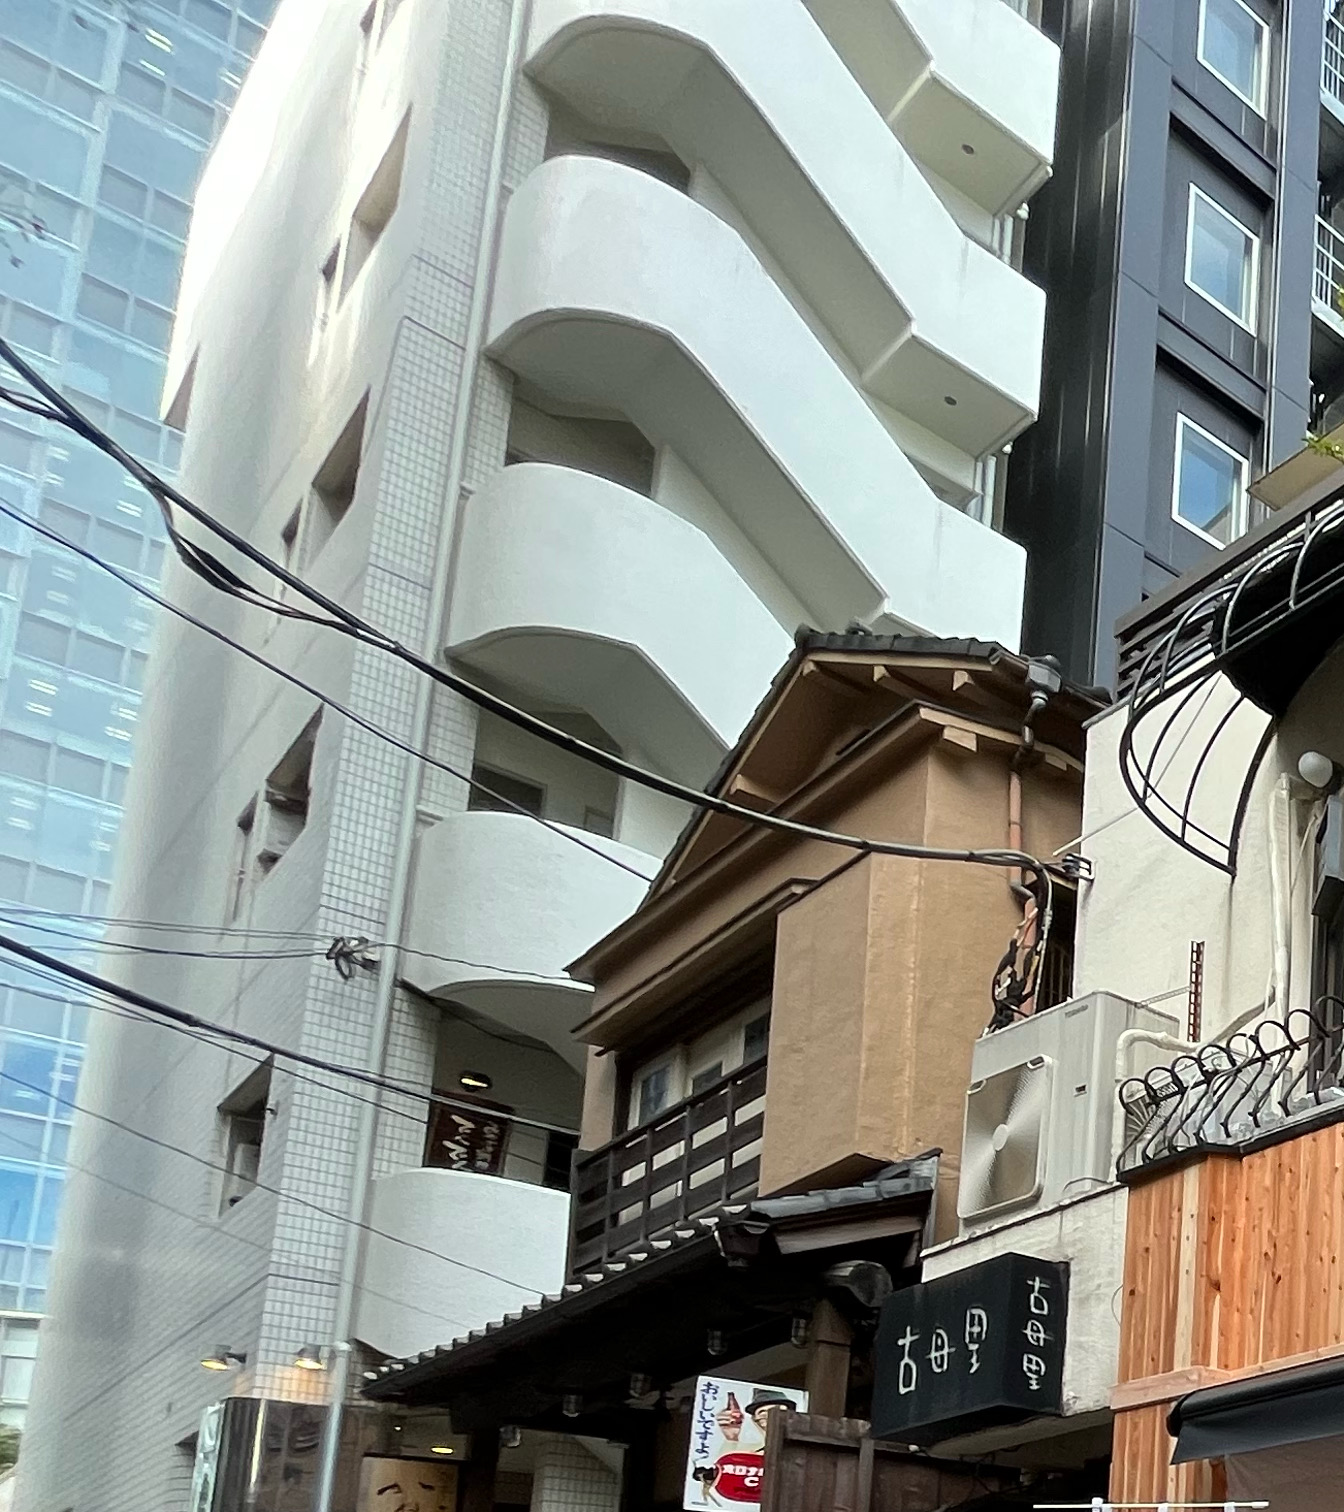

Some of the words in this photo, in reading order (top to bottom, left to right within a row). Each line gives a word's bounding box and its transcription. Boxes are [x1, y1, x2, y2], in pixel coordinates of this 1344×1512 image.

[897, 1308, 988, 1395] 古母里
[1022, 1277, 1053, 1390] 古母里
